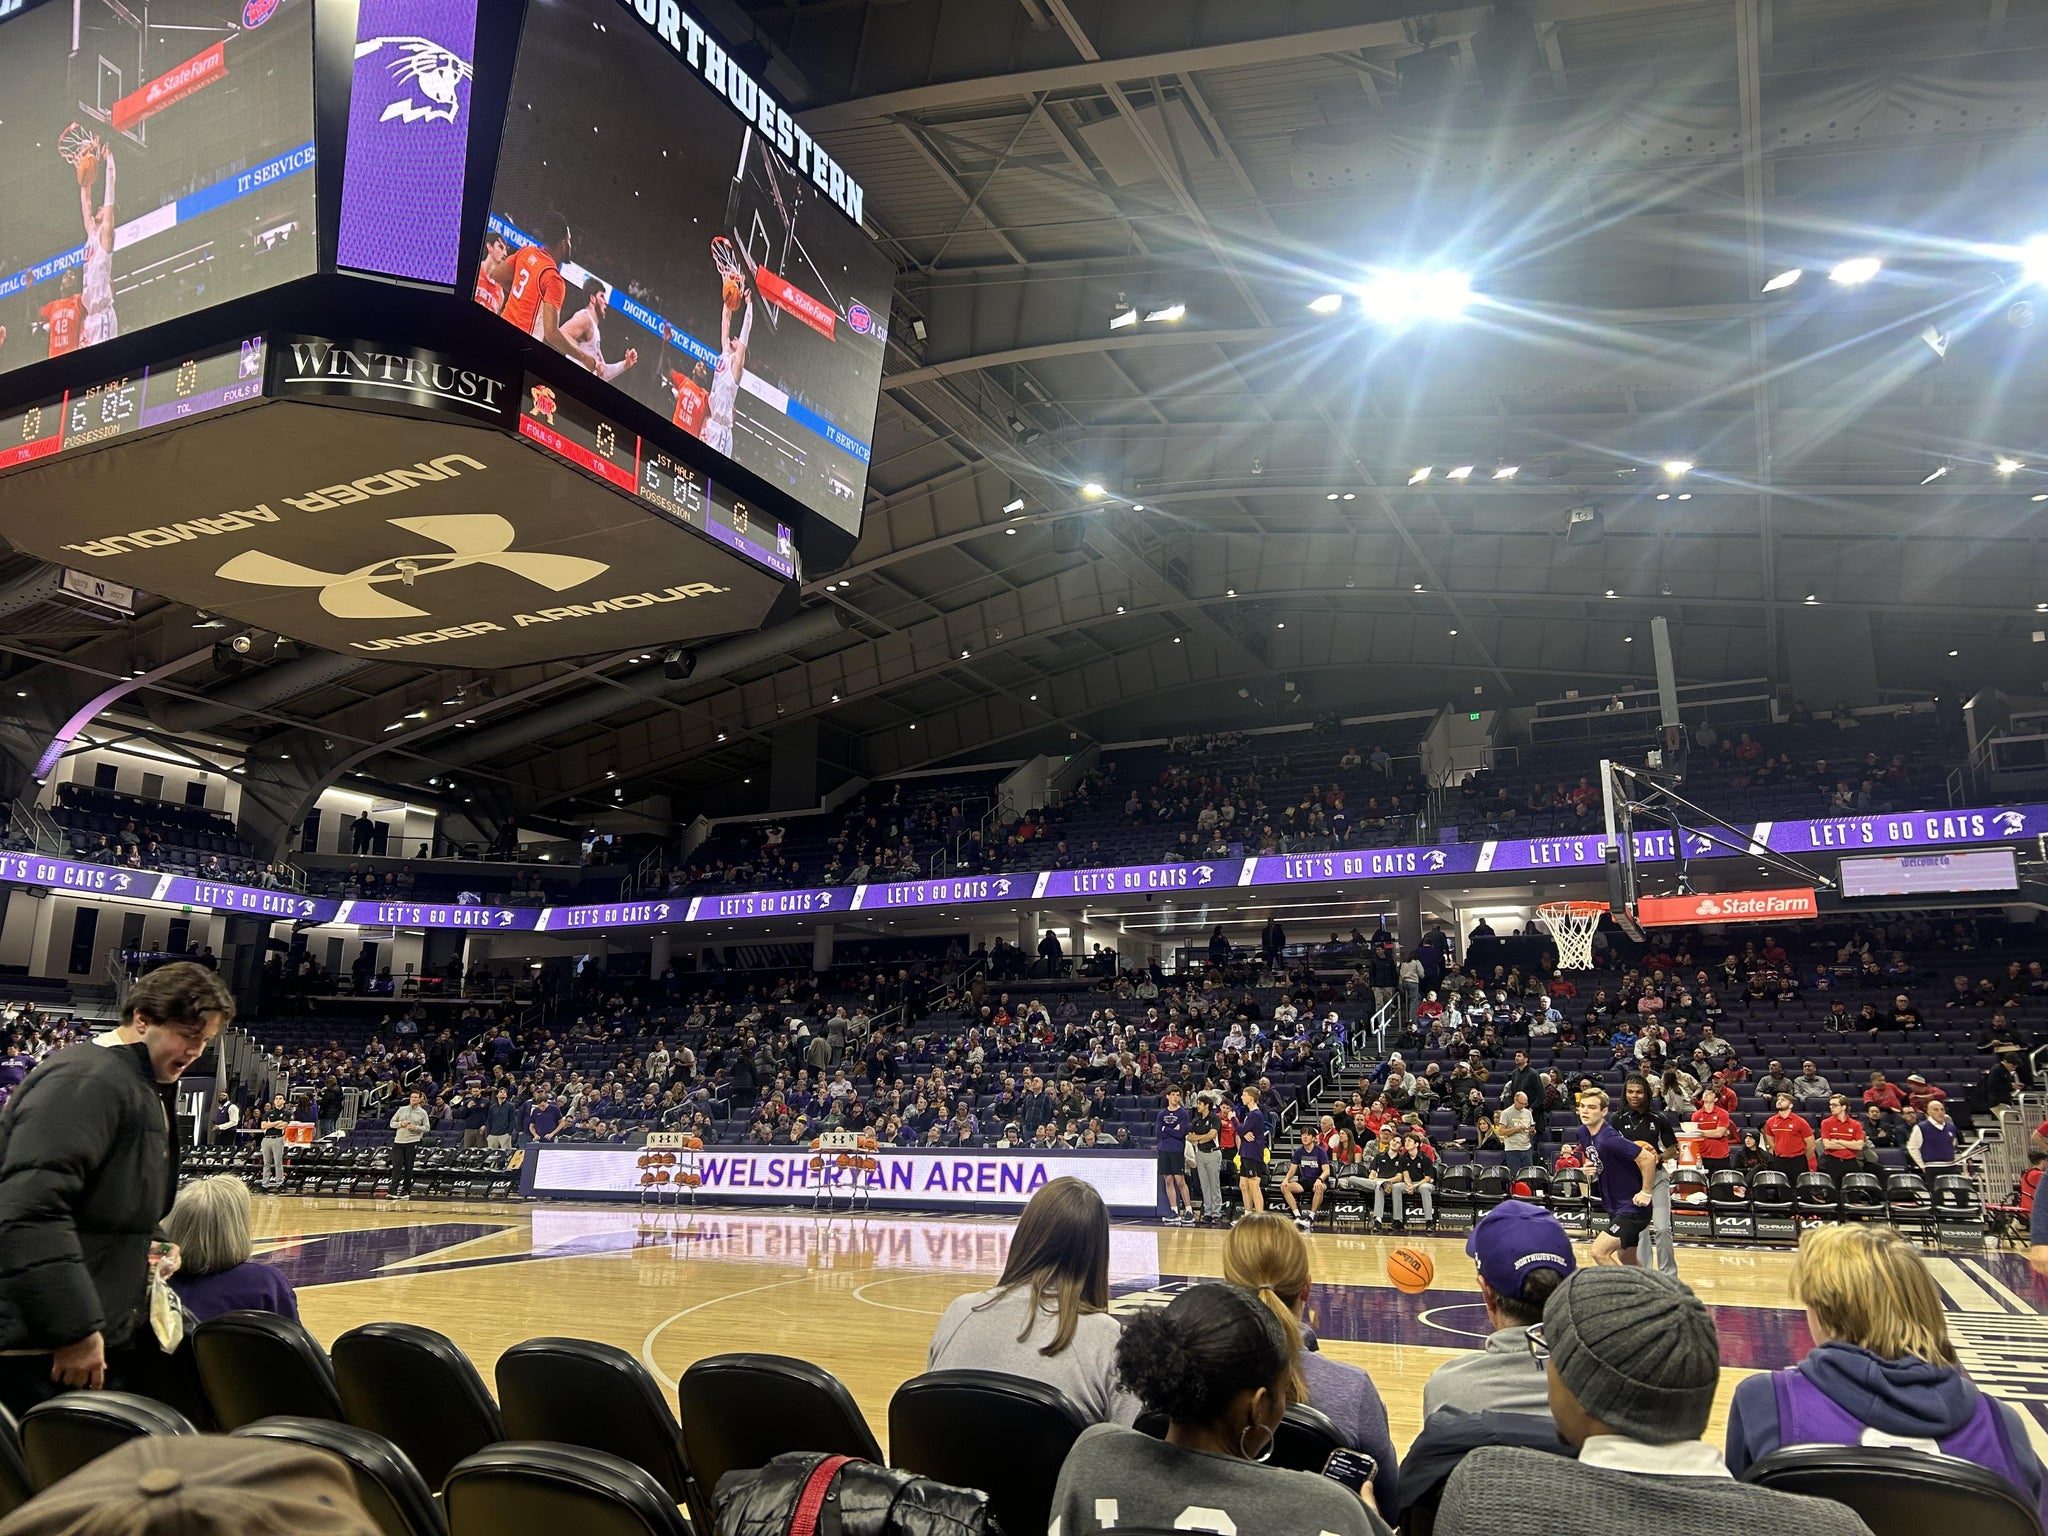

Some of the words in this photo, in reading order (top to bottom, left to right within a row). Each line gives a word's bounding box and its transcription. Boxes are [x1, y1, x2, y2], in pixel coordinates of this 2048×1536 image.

[625, 0, 863, 227] ORTHWESTERN
[237, 174, 252, 192] IT
[512, 268, 530, 299] 3
[623, 300, 657, 330] DIGITAL
[176, 360, 197, 396] 0
[290, 342, 503, 404] WINTRUST
[85, 385, 101, 400] 1ST
[104, 377, 129, 392] HALF
[223, 387, 250, 402] FOULS
[22, 407, 41, 441] 0
[71, 401, 87, 432] 6
[63, 423, 120, 449] POSSESSION
[526, 423, 553, 445] FOULS
[596, 422, 615, 458] 0
[826, 425, 836, 439] IT
[646, 459, 660, 489] 6
[657, 453, 671, 468] 1ST
[674, 463, 695, 481] HALF
[280, 453, 488, 512] UNDER
[640, 486, 691, 521] POSSESSION
[66, 503, 280, 557] ARMOUR
[733, 502, 748, 533] 0
[767, 555, 785, 571] FOULS
[95, 582, 104, 597] N
[350, 621, 506, 651] UNDER
[513, 582, 723, 627] ARMOUR
[1809, 822, 1873, 847] LET'S
[1889, 821, 1913, 840] GO
[1926, 815, 1984, 839] CATS
[1529, 841, 1584, 864] LET'S
[1902, 856, 1938, 868] Welcome
[1939, 856, 1950, 866] to
[37, 864, 56, 881] GO
[64, 866, 104, 889] CATS
[1285, 857, 1333, 880] LET'S
[1344, 857, 1362, 875] GO
[1372, 853, 1416, 874] CATS
[887, 884, 924, 904] LET'S
[932, 884, 947, 900] GO
[954, 881, 987, 899] CATS
[1074, 872, 1115, 893] LET'S
[1124, 871, 1140, 887] GO
[1149, 868, 1187, 887] CATS
[194, 884, 234, 906] LET'S
[242, 894, 256, 908] GO
[263, 894, 294, 914] CATS
[719, 897, 753, 916] LET'S
[760, 897, 774, 912] GO
[780, 893, 811, 911] CATS
[1722, 896, 1809, 914] StateFarm
[378, 906, 420, 923] LET'S
[429, 910, 446, 923] GO
[453, 910, 489, 926] CATS
[567, 909, 598, 926] LET'S
[604, 910, 617, 922] GO
[622, 905, 650, 921] CATS
[650, 1135, 656, 1144] N
[673, 1135, 679, 1143] N
[822, 1133, 828, 1142] N
[848, 1133, 854, 1142] N
[924, 1160, 1049, 1193] ARENA
